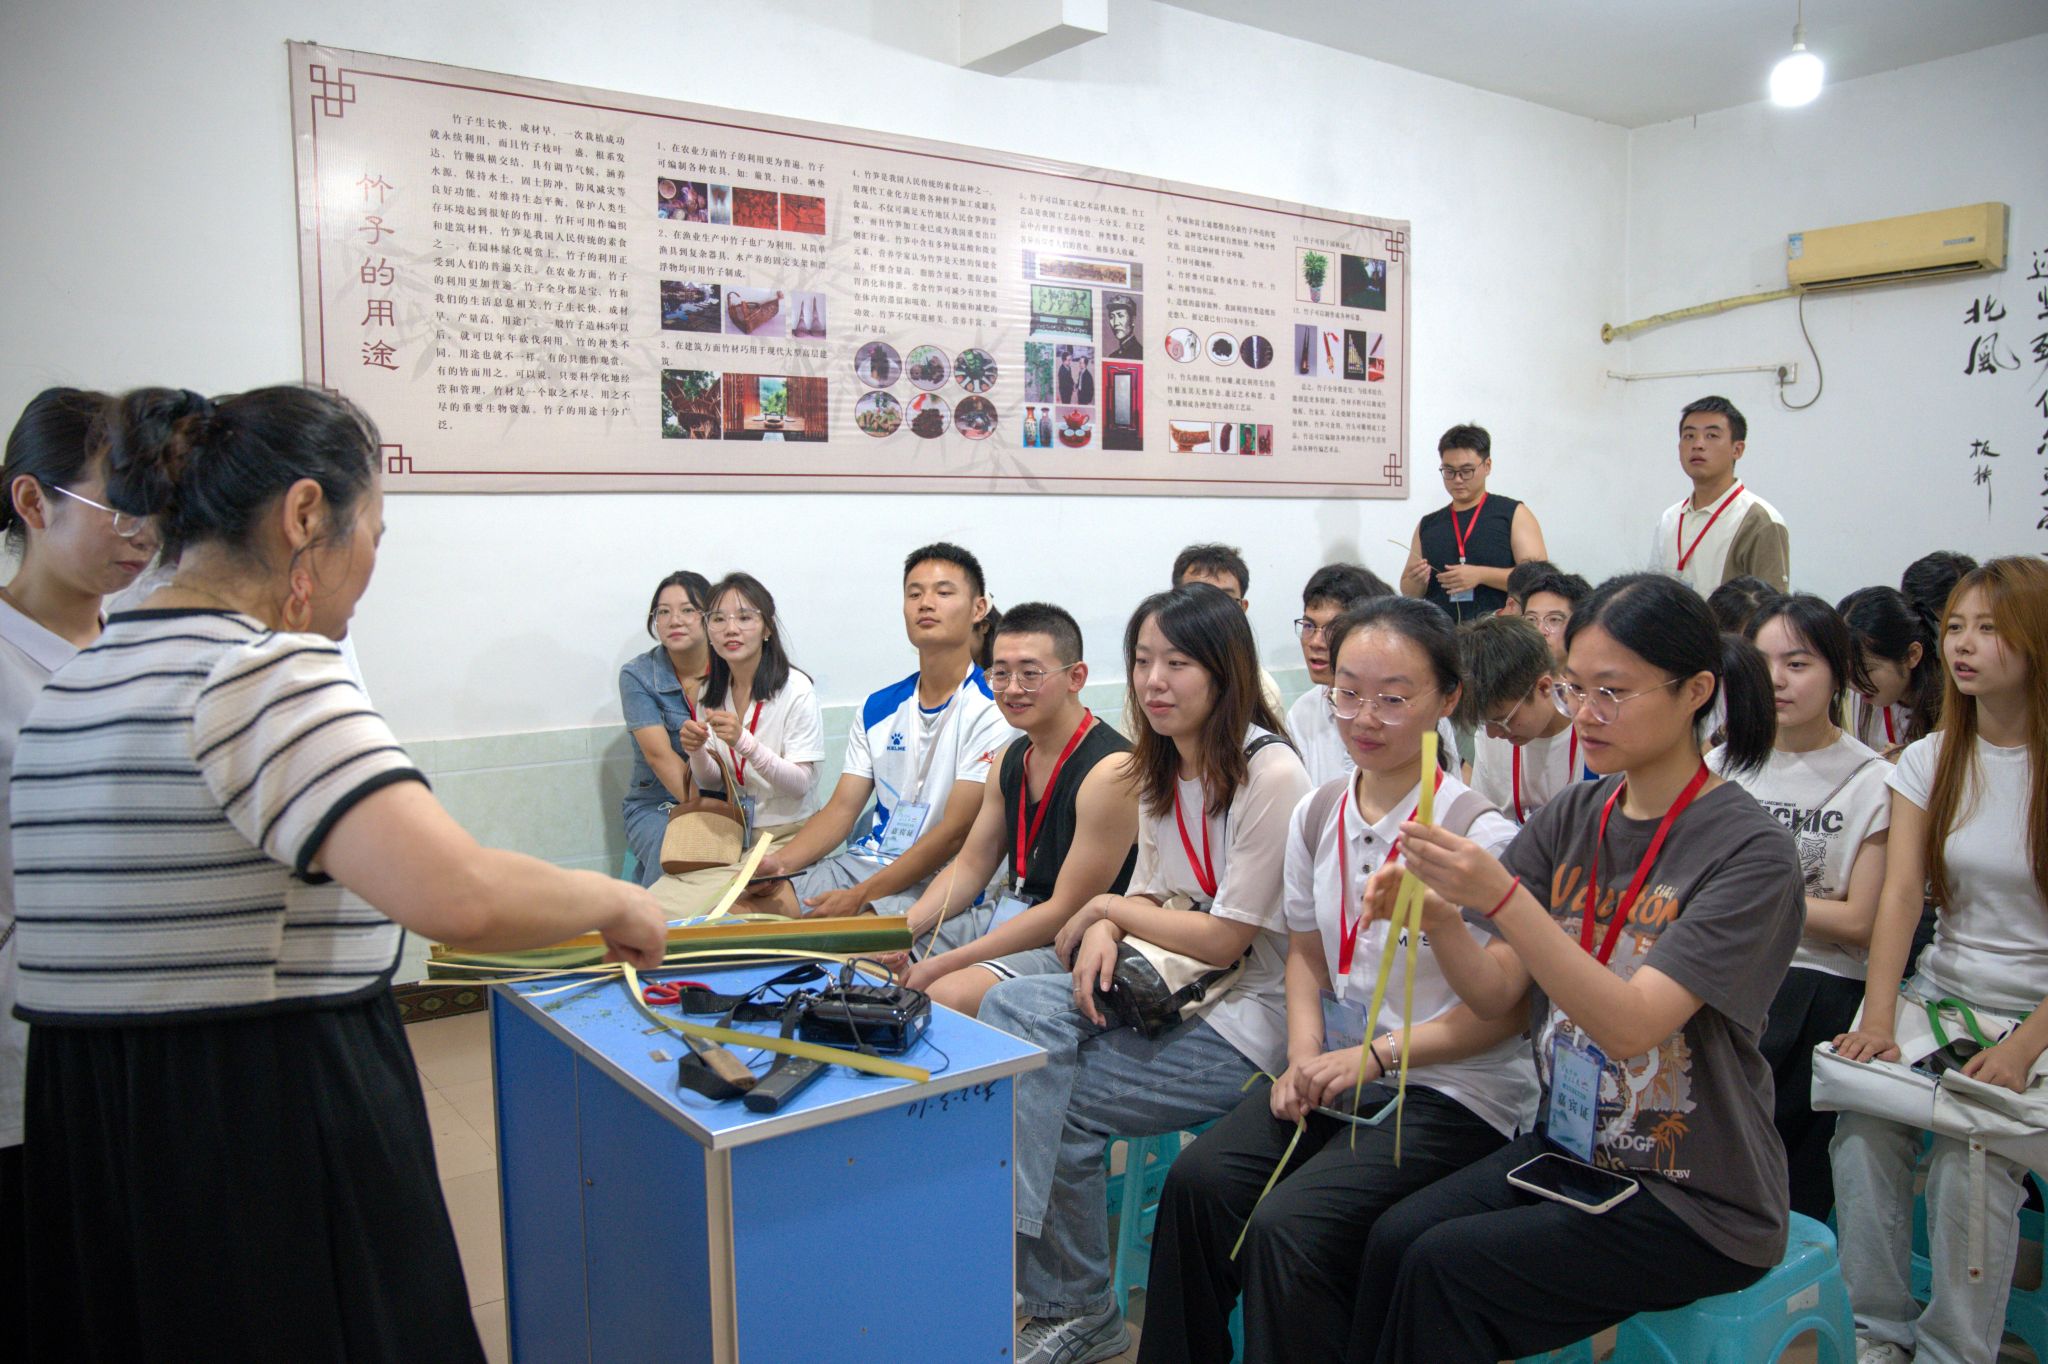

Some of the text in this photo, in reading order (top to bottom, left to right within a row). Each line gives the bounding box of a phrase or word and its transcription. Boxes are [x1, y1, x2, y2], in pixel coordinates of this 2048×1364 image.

[355, 173, 400, 371] 竹子的用途
